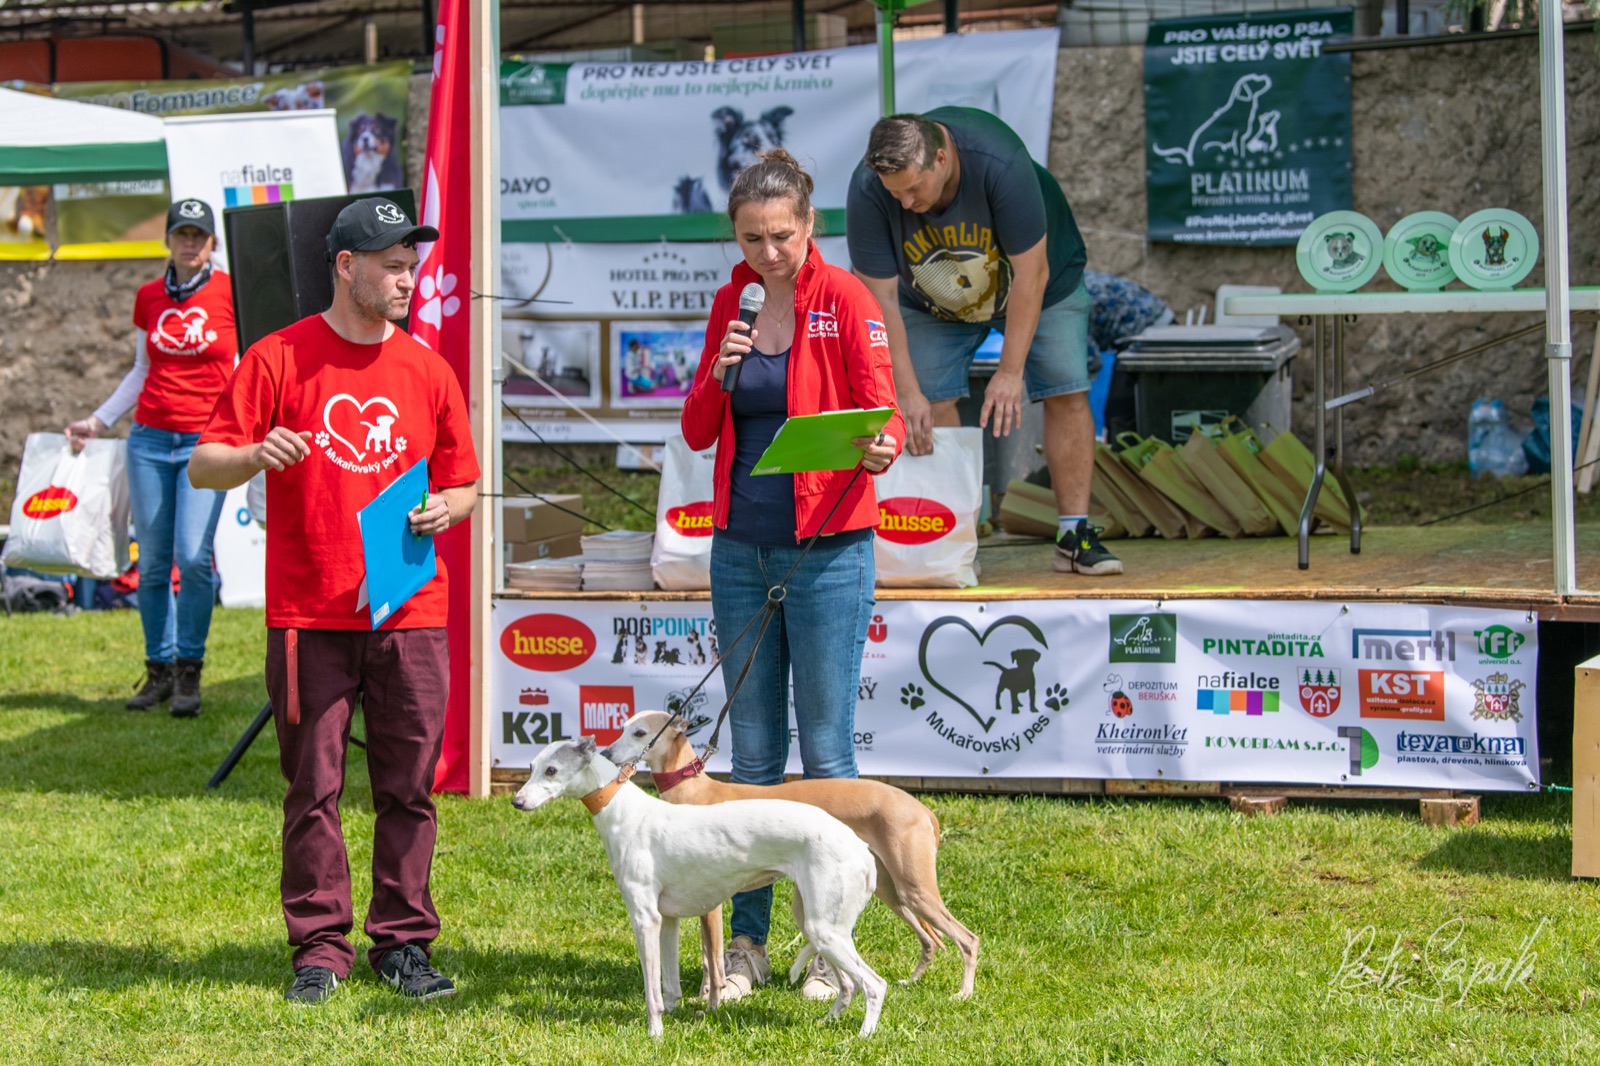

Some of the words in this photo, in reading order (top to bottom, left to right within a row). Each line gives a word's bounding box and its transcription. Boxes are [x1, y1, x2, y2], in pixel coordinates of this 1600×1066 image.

[1163, 29, 1208, 44] PRO
[1210, 22, 1291, 42] VAŠEHO
[1293, 20, 1334, 37] PSA
[1170, 46, 1218, 66] JSTE
[1220, 39, 1271, 62] CELÝ
[1273, 37, 1324, 60] SVĚT
[583, 65, 626, 81] PRO
[674, 59, 723, 77] JSTE
[221, 164, 294, 184] nafialce
[1191, 167, 1310, 195] PLATINUM
[609, 269, 658, 281] HOTEL
[662, 269, 690, 281] PRO
[693, 269, 720, 281] PSY
[612, 290, 664, 309] V.I.P.
[325, 447, 381, 474] Mukařovský
[381, 452, 399, 469] pes
[675, 510, 713, 529] hus
[613, 617, 708, 636] DOGPOINT
[512, 629, 584, 655] husse
[1267, 632, 1322, 642] pintadita.cz
[1125, 646, 1161, 655] PLATINUM
[1203, 638, 1325, 658] PINTADITA
[1128, 681, 1178, 690] DEPOZITUM
[1198, 672, 1280, 690] nafialce
[1371, 672, 1431, 696] KST
[1138, 690, 1177, 701] BERUŠKA
[583, 702, 630, 730] MAPES
[502, 712, 572, 745] K2L
[925, 711, 1021, 753] Mukařovský
[1023, 715, 1050, 744] pes
[1096, 723, 1189, 742] KheironVet
[1096, 746, 1154, 756] veterinární
[1155, 745, 1186, 758] služby
[1205, 736, 1300, 750] KOVOBRAM
[1303, 740, 1346, 752] s.r.o.
